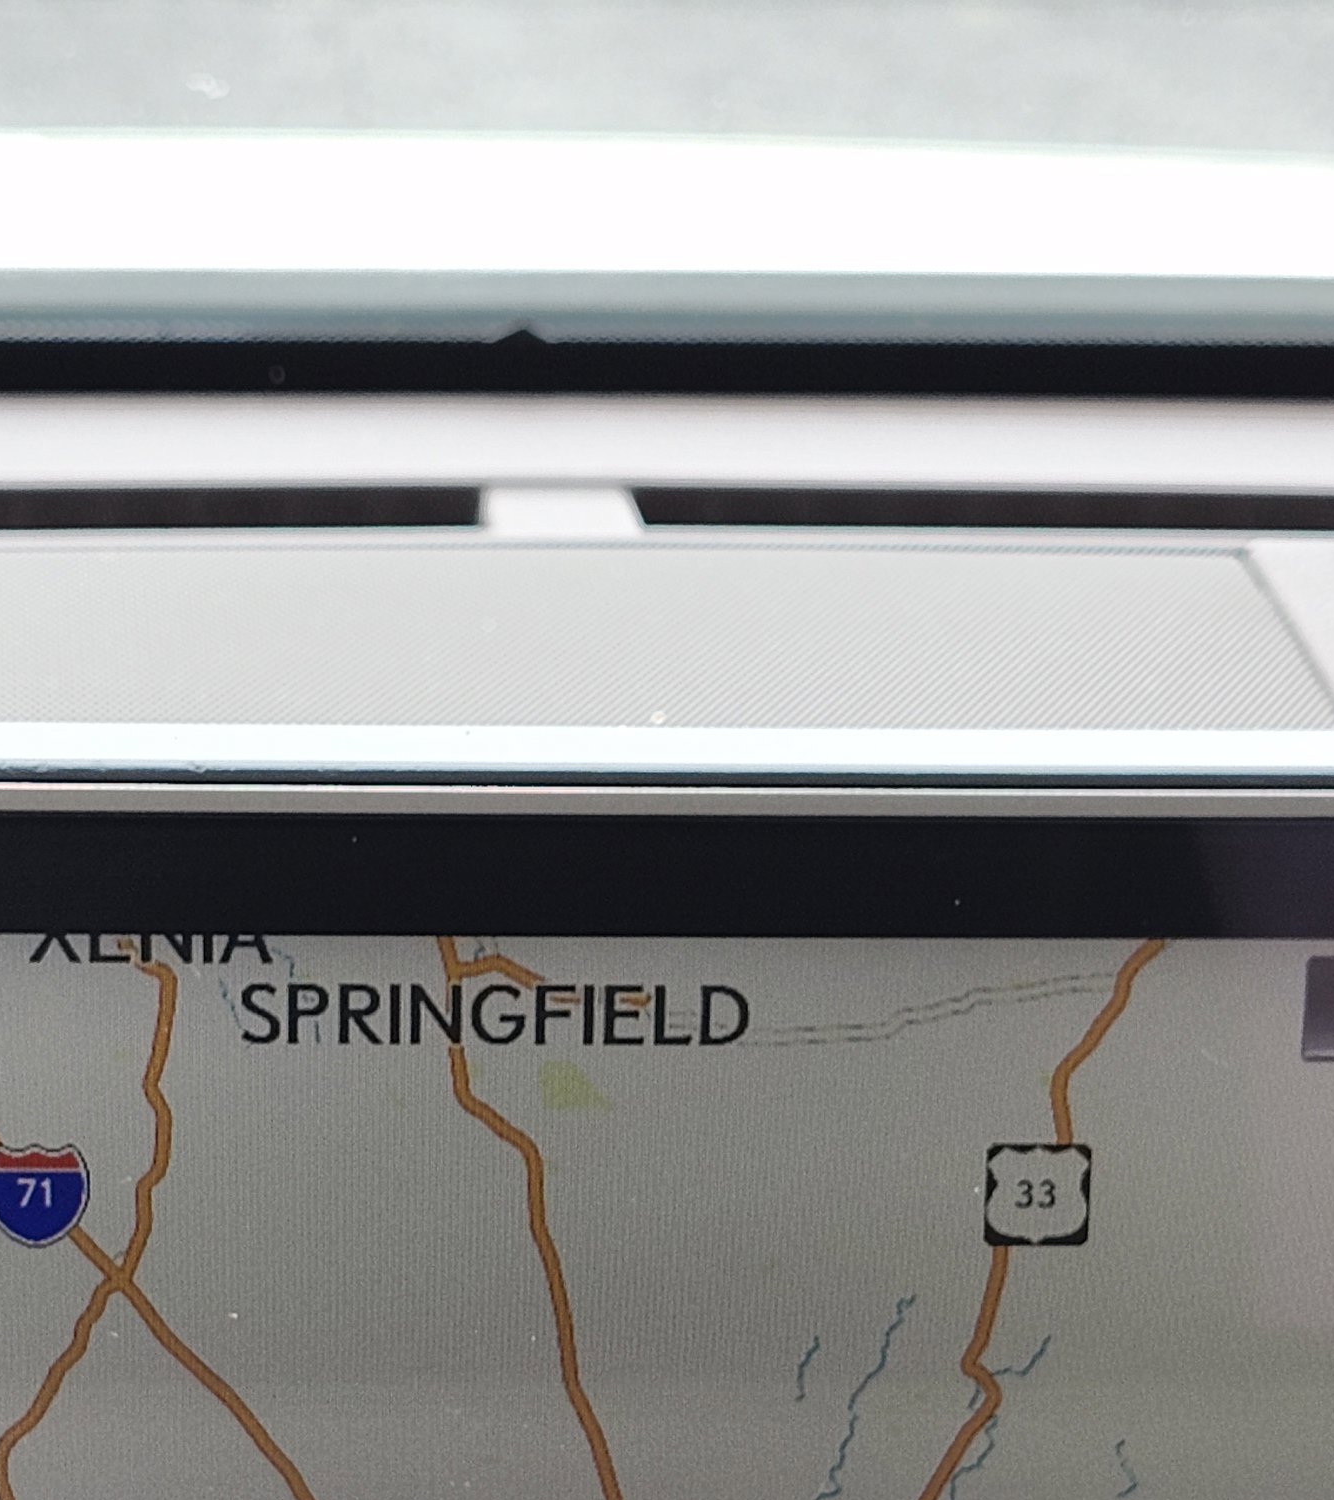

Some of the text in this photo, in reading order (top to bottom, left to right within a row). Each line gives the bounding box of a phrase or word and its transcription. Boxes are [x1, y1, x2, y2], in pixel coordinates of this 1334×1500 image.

[241, 983, 750, 1046] SPRINGFIELD
[15, 1178, 53, 1209] 71
[1014, 1178, 1056, 1209] 33
